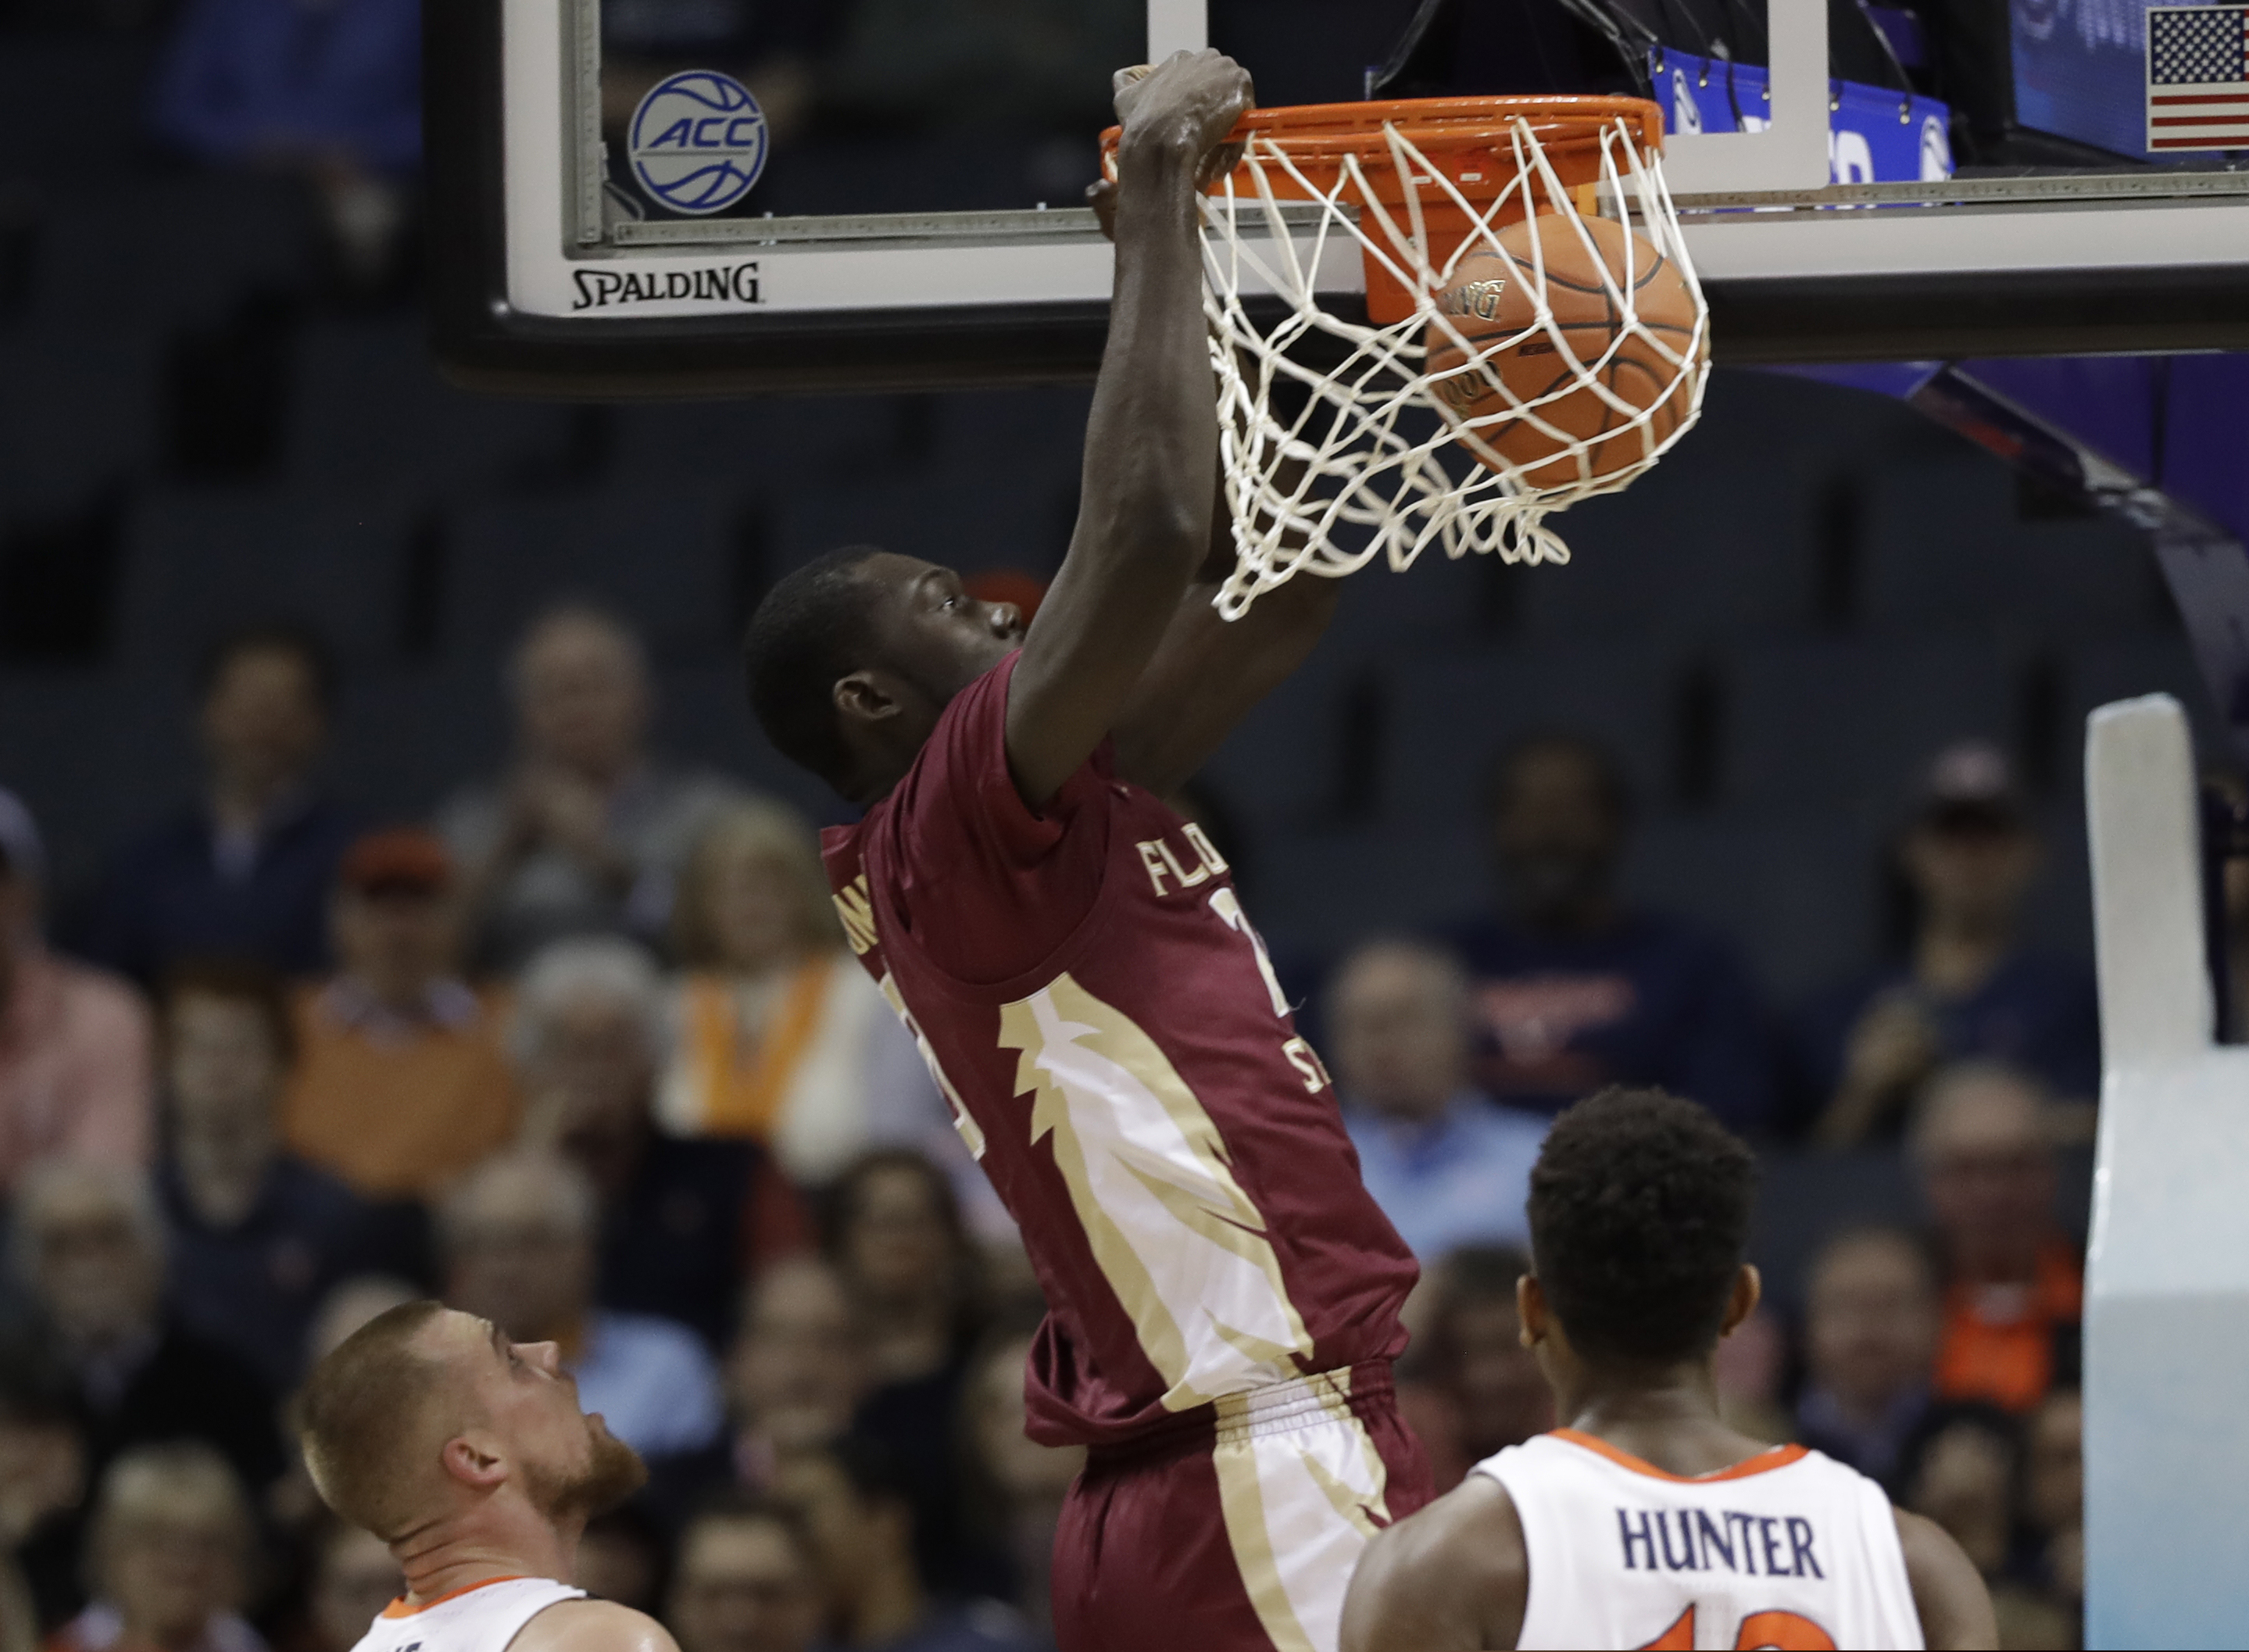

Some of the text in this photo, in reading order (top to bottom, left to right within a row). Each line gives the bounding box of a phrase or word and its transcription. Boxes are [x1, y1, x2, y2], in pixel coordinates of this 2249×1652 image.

[648, 118, 759, 148] ACC
[573, 262, 760, 310] SPALDING
[1615, 1507, 1825, 1579] HUNTER
